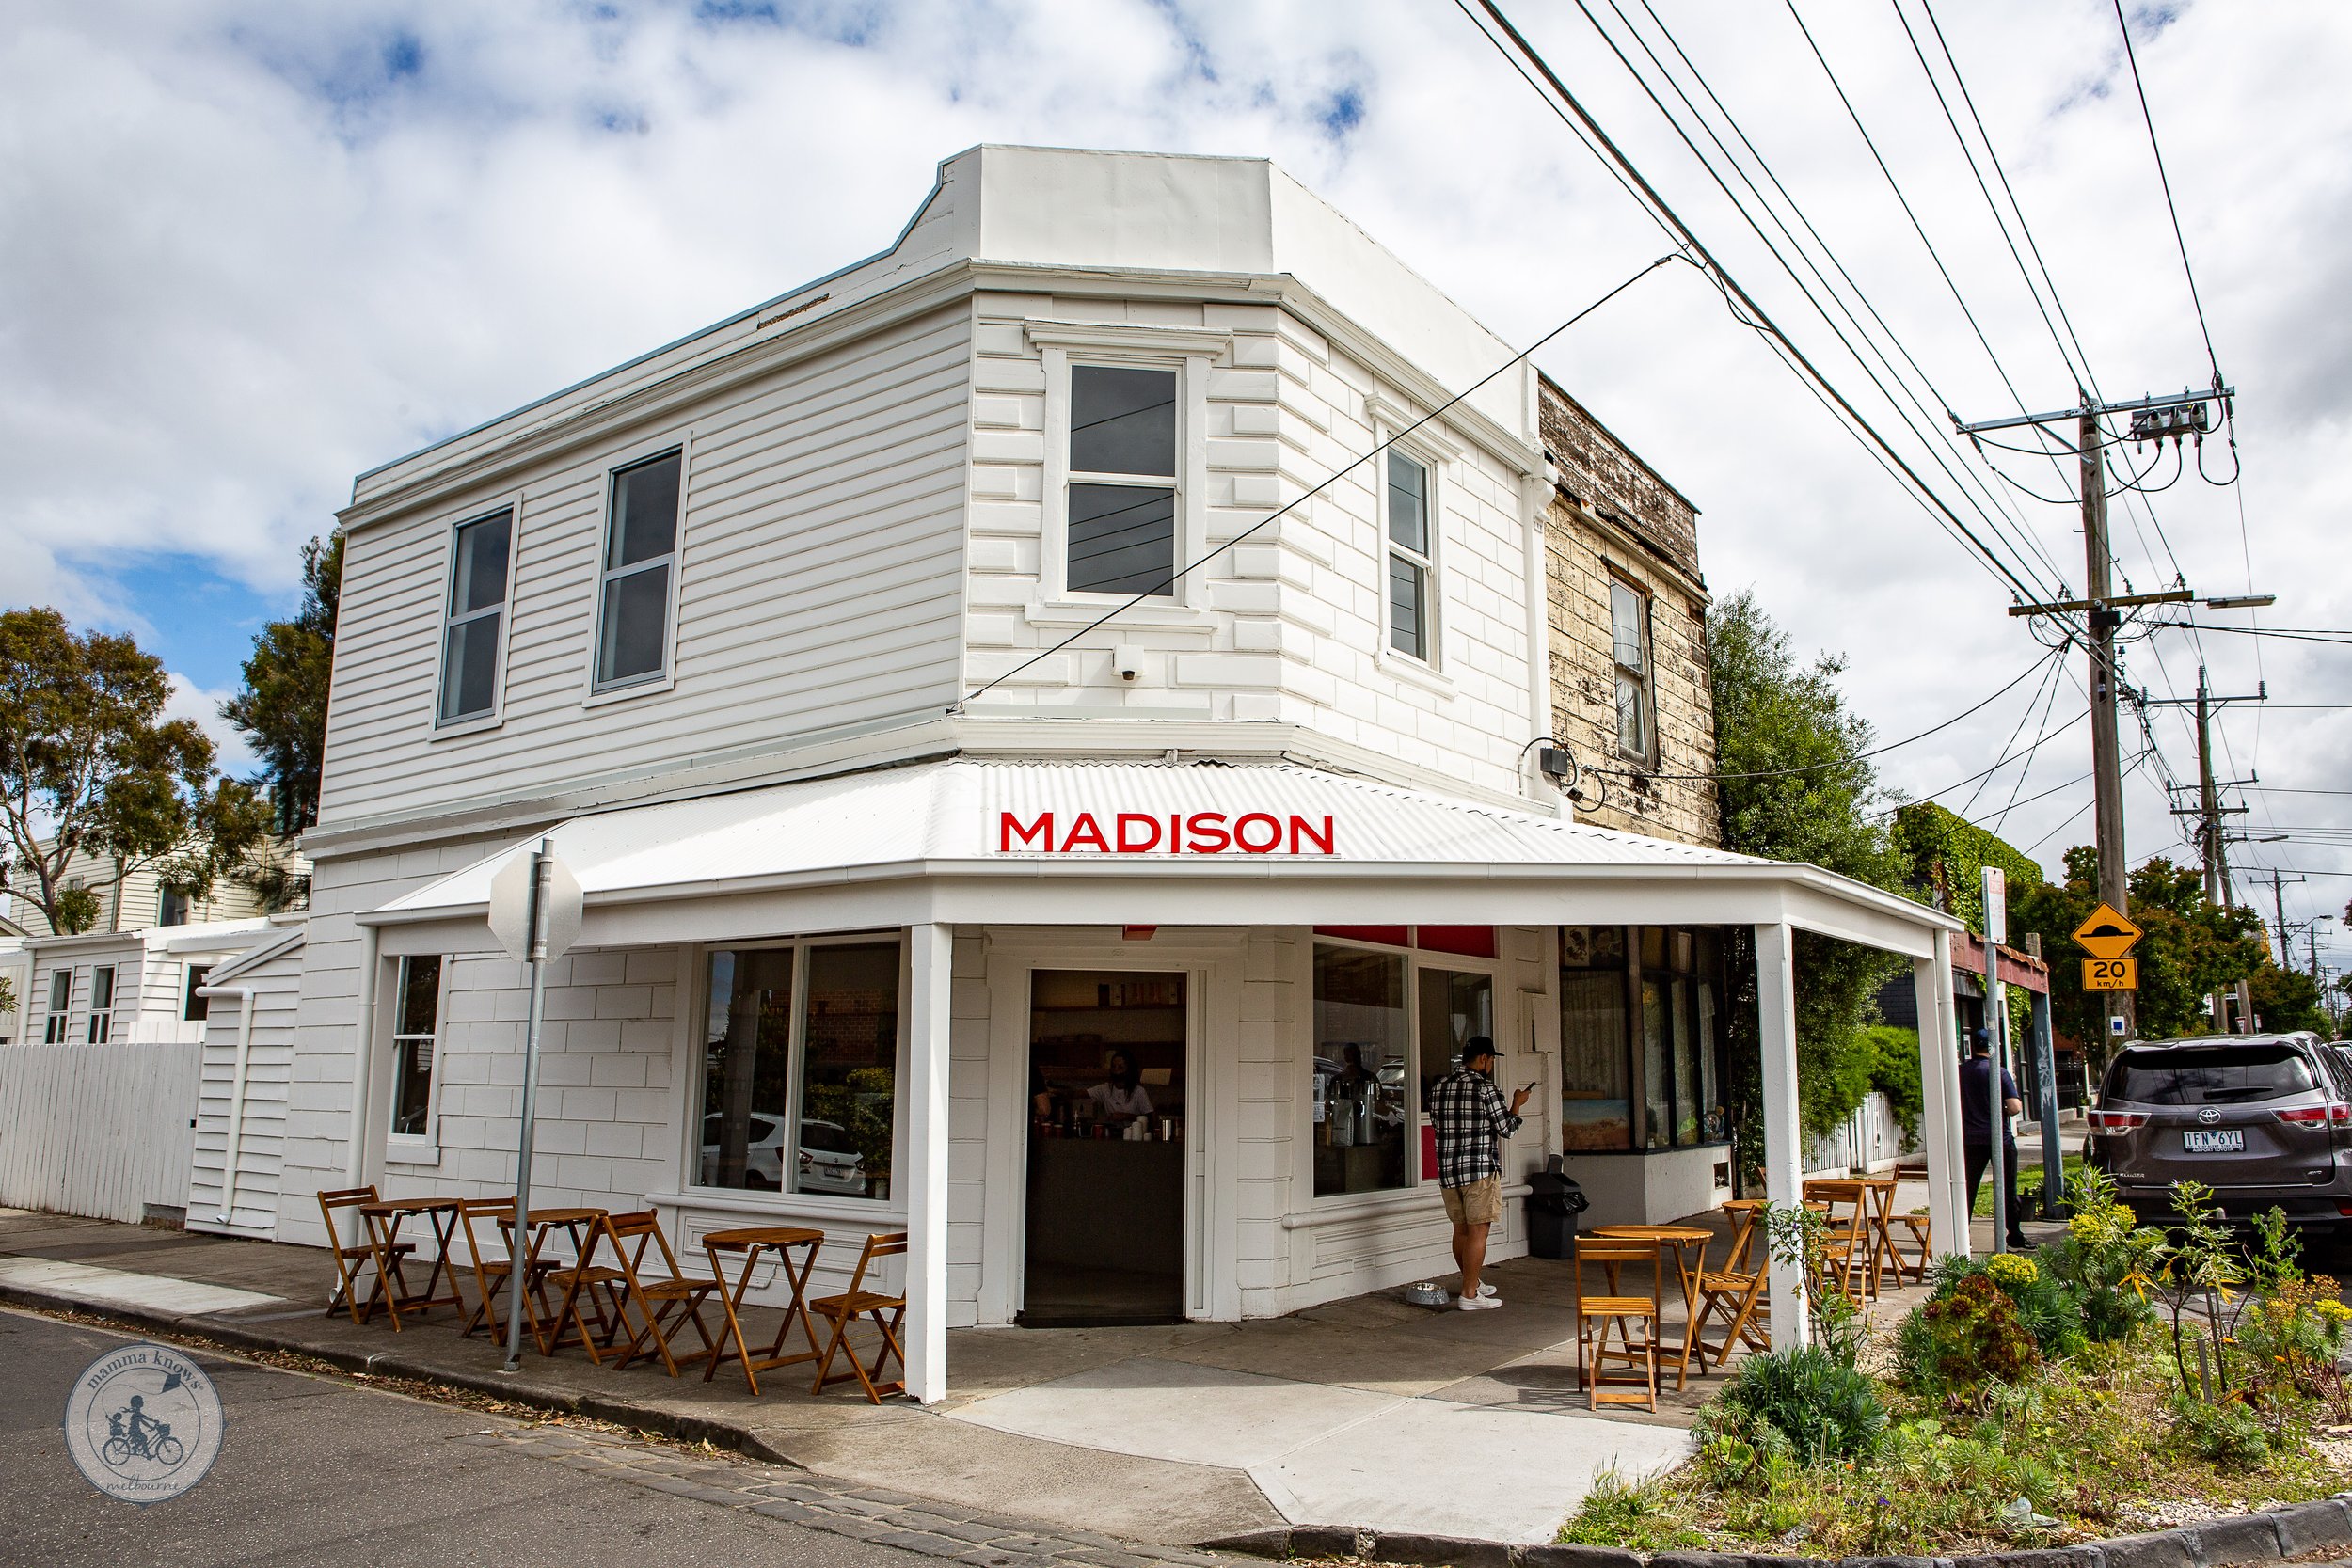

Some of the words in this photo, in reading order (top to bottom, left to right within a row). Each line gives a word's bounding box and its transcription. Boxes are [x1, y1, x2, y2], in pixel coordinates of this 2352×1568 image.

[1000, 812, 1334, 854] MADISON
[2093, 961, 2126, 978] 20
[2097, 979, 2124, 989] km/h
[2186, 1132, 2209, 1145] 1FN
[2218, 1132, 2242, 1145] 6YL
